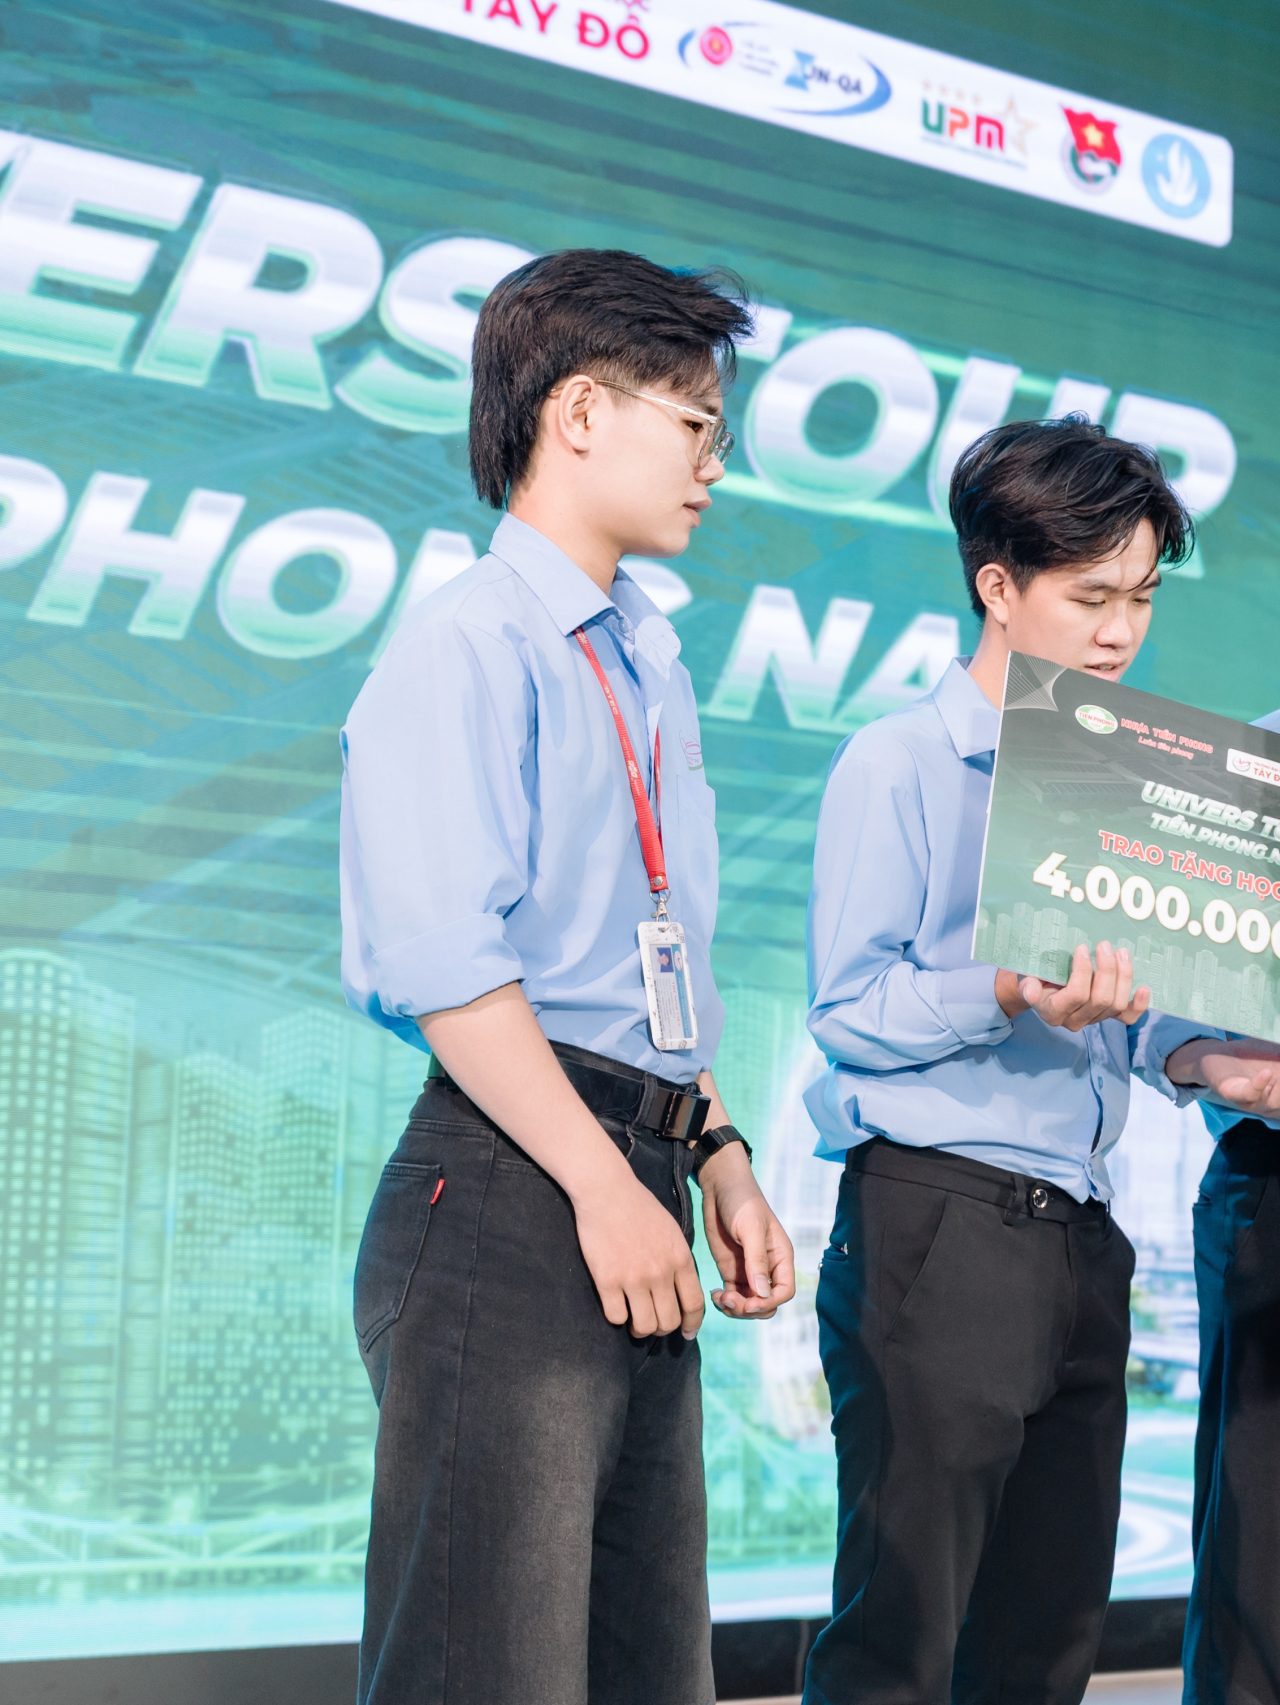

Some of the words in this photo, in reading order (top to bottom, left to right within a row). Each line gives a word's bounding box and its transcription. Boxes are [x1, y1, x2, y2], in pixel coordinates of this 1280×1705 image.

[577, 11, 650, 60] ĐÔ
[0, 128, 545, 434] ERS
[735, 302, 1238, 578] OUR
[1141, 780, 1259, 832] UNIVERS
[1098, 830, 1164, 866] TRAO
[1168, 849, 1232, 885] TẶNG
[1195, 826, 1269, 861] PHONG
